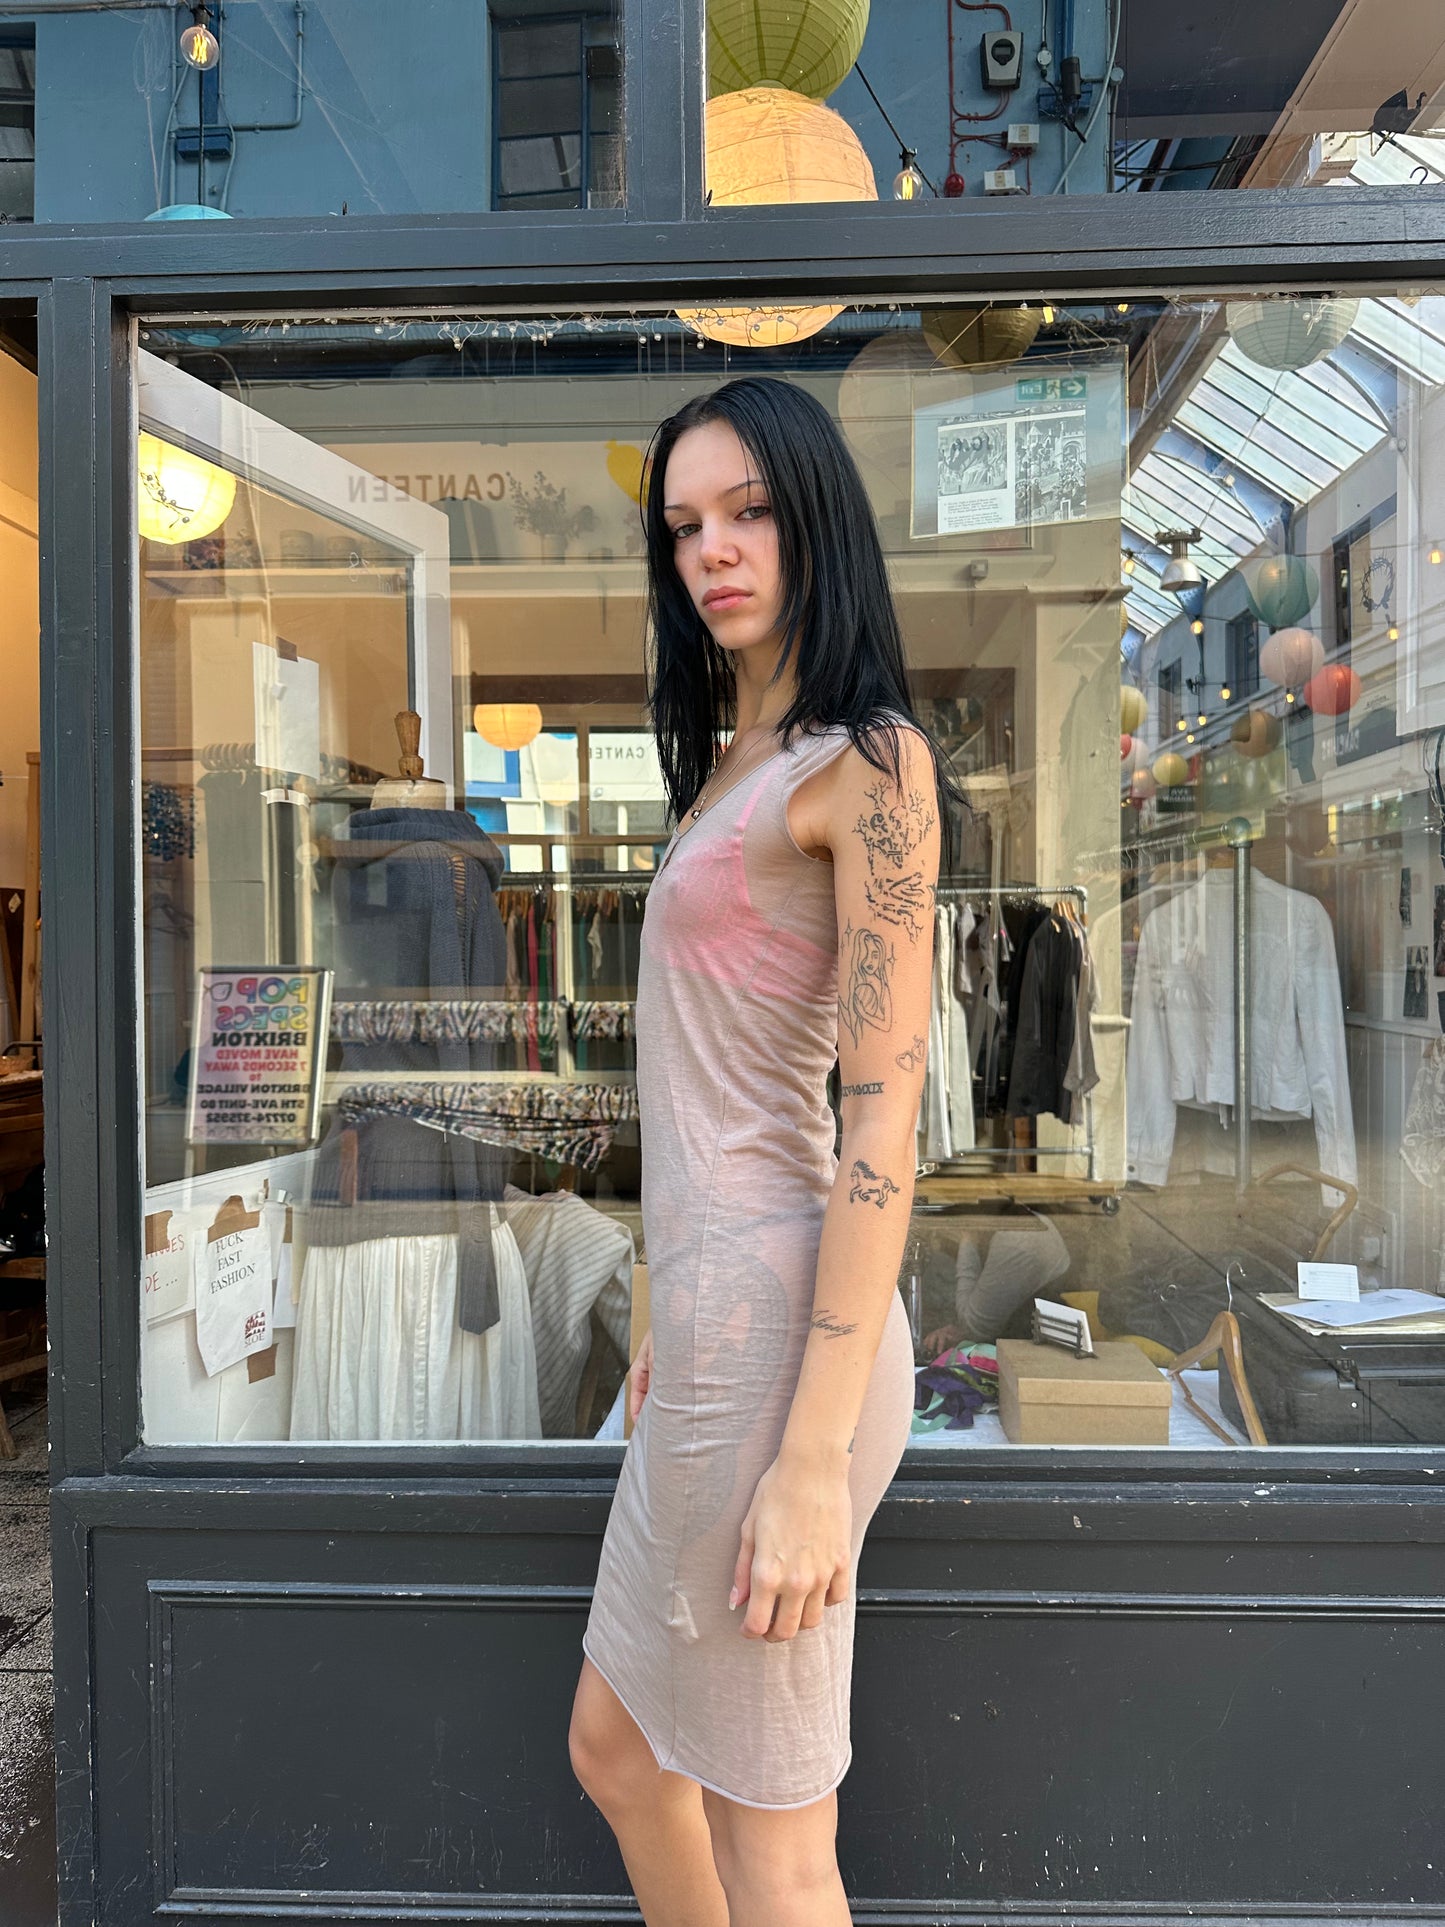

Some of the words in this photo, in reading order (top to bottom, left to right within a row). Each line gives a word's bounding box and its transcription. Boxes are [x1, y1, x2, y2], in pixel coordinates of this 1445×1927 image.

[215, 1231, 244, 1254] FUCK
[218, 1249, 243, 1271] FAST
[210, 1262, 256, 1294] FASHION
